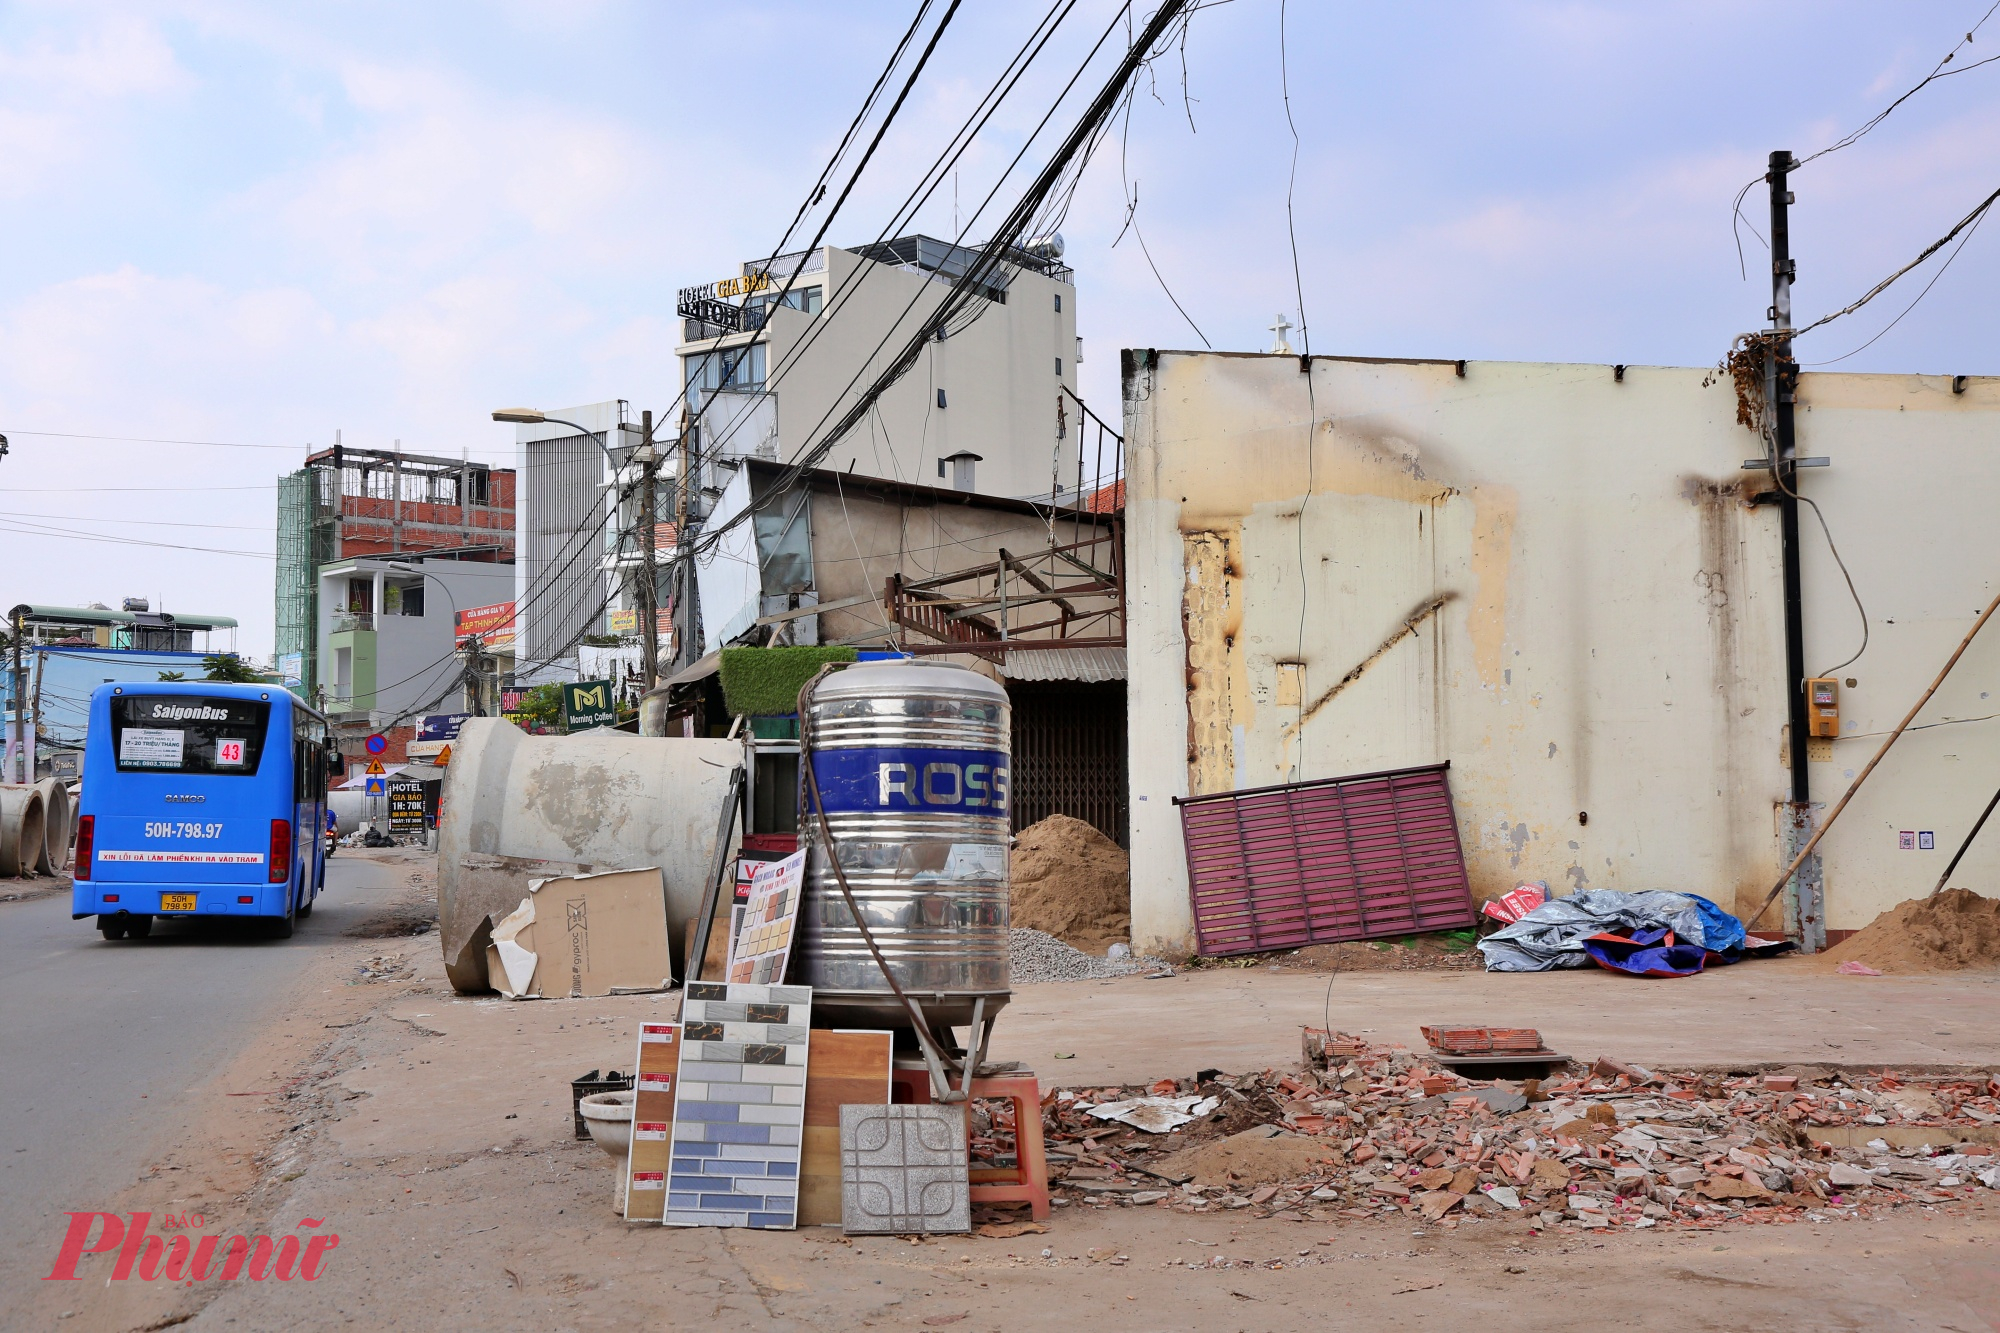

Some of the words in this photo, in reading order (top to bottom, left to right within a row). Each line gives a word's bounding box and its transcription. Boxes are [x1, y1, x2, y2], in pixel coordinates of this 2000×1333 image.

[677, 283, 715, 305] HOTEL
[717, 279, 740, 298] GIA
[461, 621, 474, 630] T&P
[152, 704, 228, 720] SaigonBus
[570, 714, 594, 724] Morning
[594, 712, 612, 721] Coffee
[221, 744, 240, 760] 43
[392, 784, 422, 792] HOTEL
[164, 794, 206, 803] SAMCO
[408, 792, 422, 800] BẢO
[392, 802, 406, 810] 1H:
[407, 802, 422, 810] 70K
[144, 822, 222, 838] 50H-798.97
[572, 932, 582, 965] gyproc
